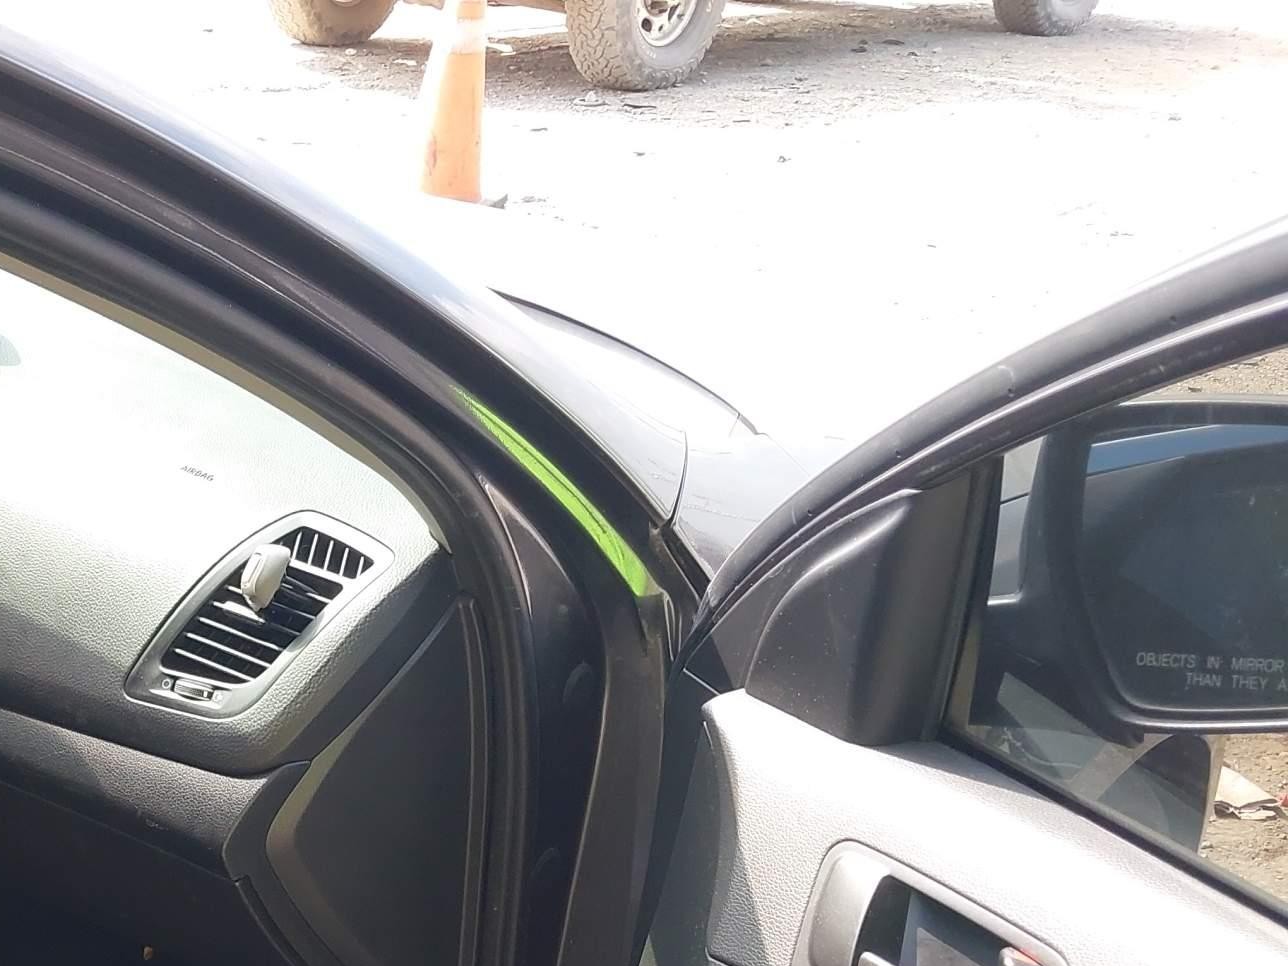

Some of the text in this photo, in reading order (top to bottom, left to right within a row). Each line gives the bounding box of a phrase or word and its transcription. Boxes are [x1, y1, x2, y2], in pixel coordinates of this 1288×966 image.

[180, 465, 214, 481] AIRBAG
[1136, 652, 1285, 673] OBJECTS IN MIRROR
[1185, 672, 1223, 688] THAN
[1232, 675, 1268, 690] THEY
